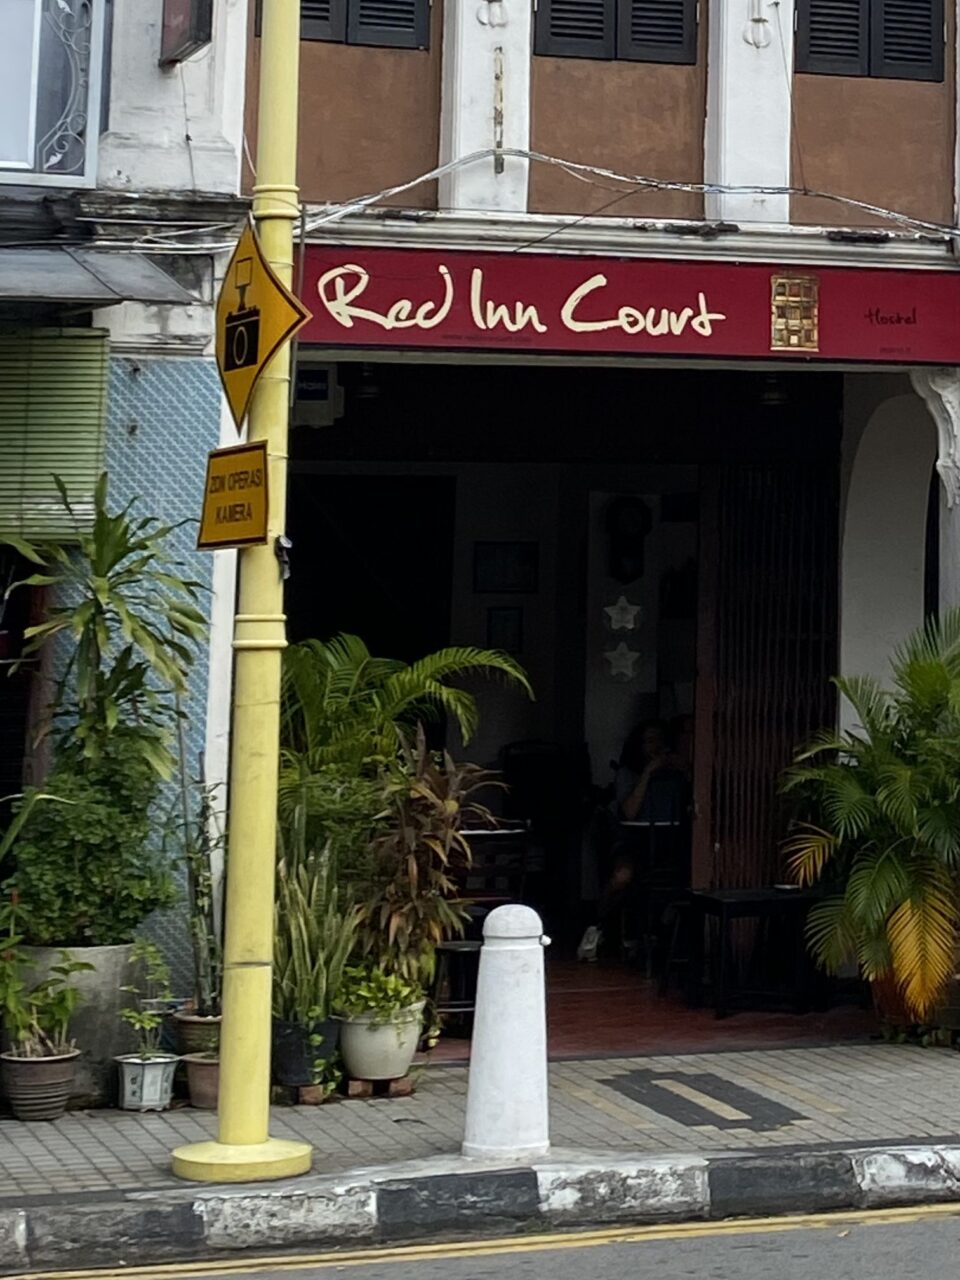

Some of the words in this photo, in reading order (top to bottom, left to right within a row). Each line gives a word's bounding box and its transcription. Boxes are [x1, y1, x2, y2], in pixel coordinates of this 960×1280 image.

[318, 265, 453, 330] Red
[471, 269, 548, 333] Inn
[561, 275, 726, 337] Court
[864, 306, 917, 325] Hostel
[210, 474, 226, 494] ZON
[228, 467, 263, 491] OPERASI
[215, 502, 253, 524] KAMERA
